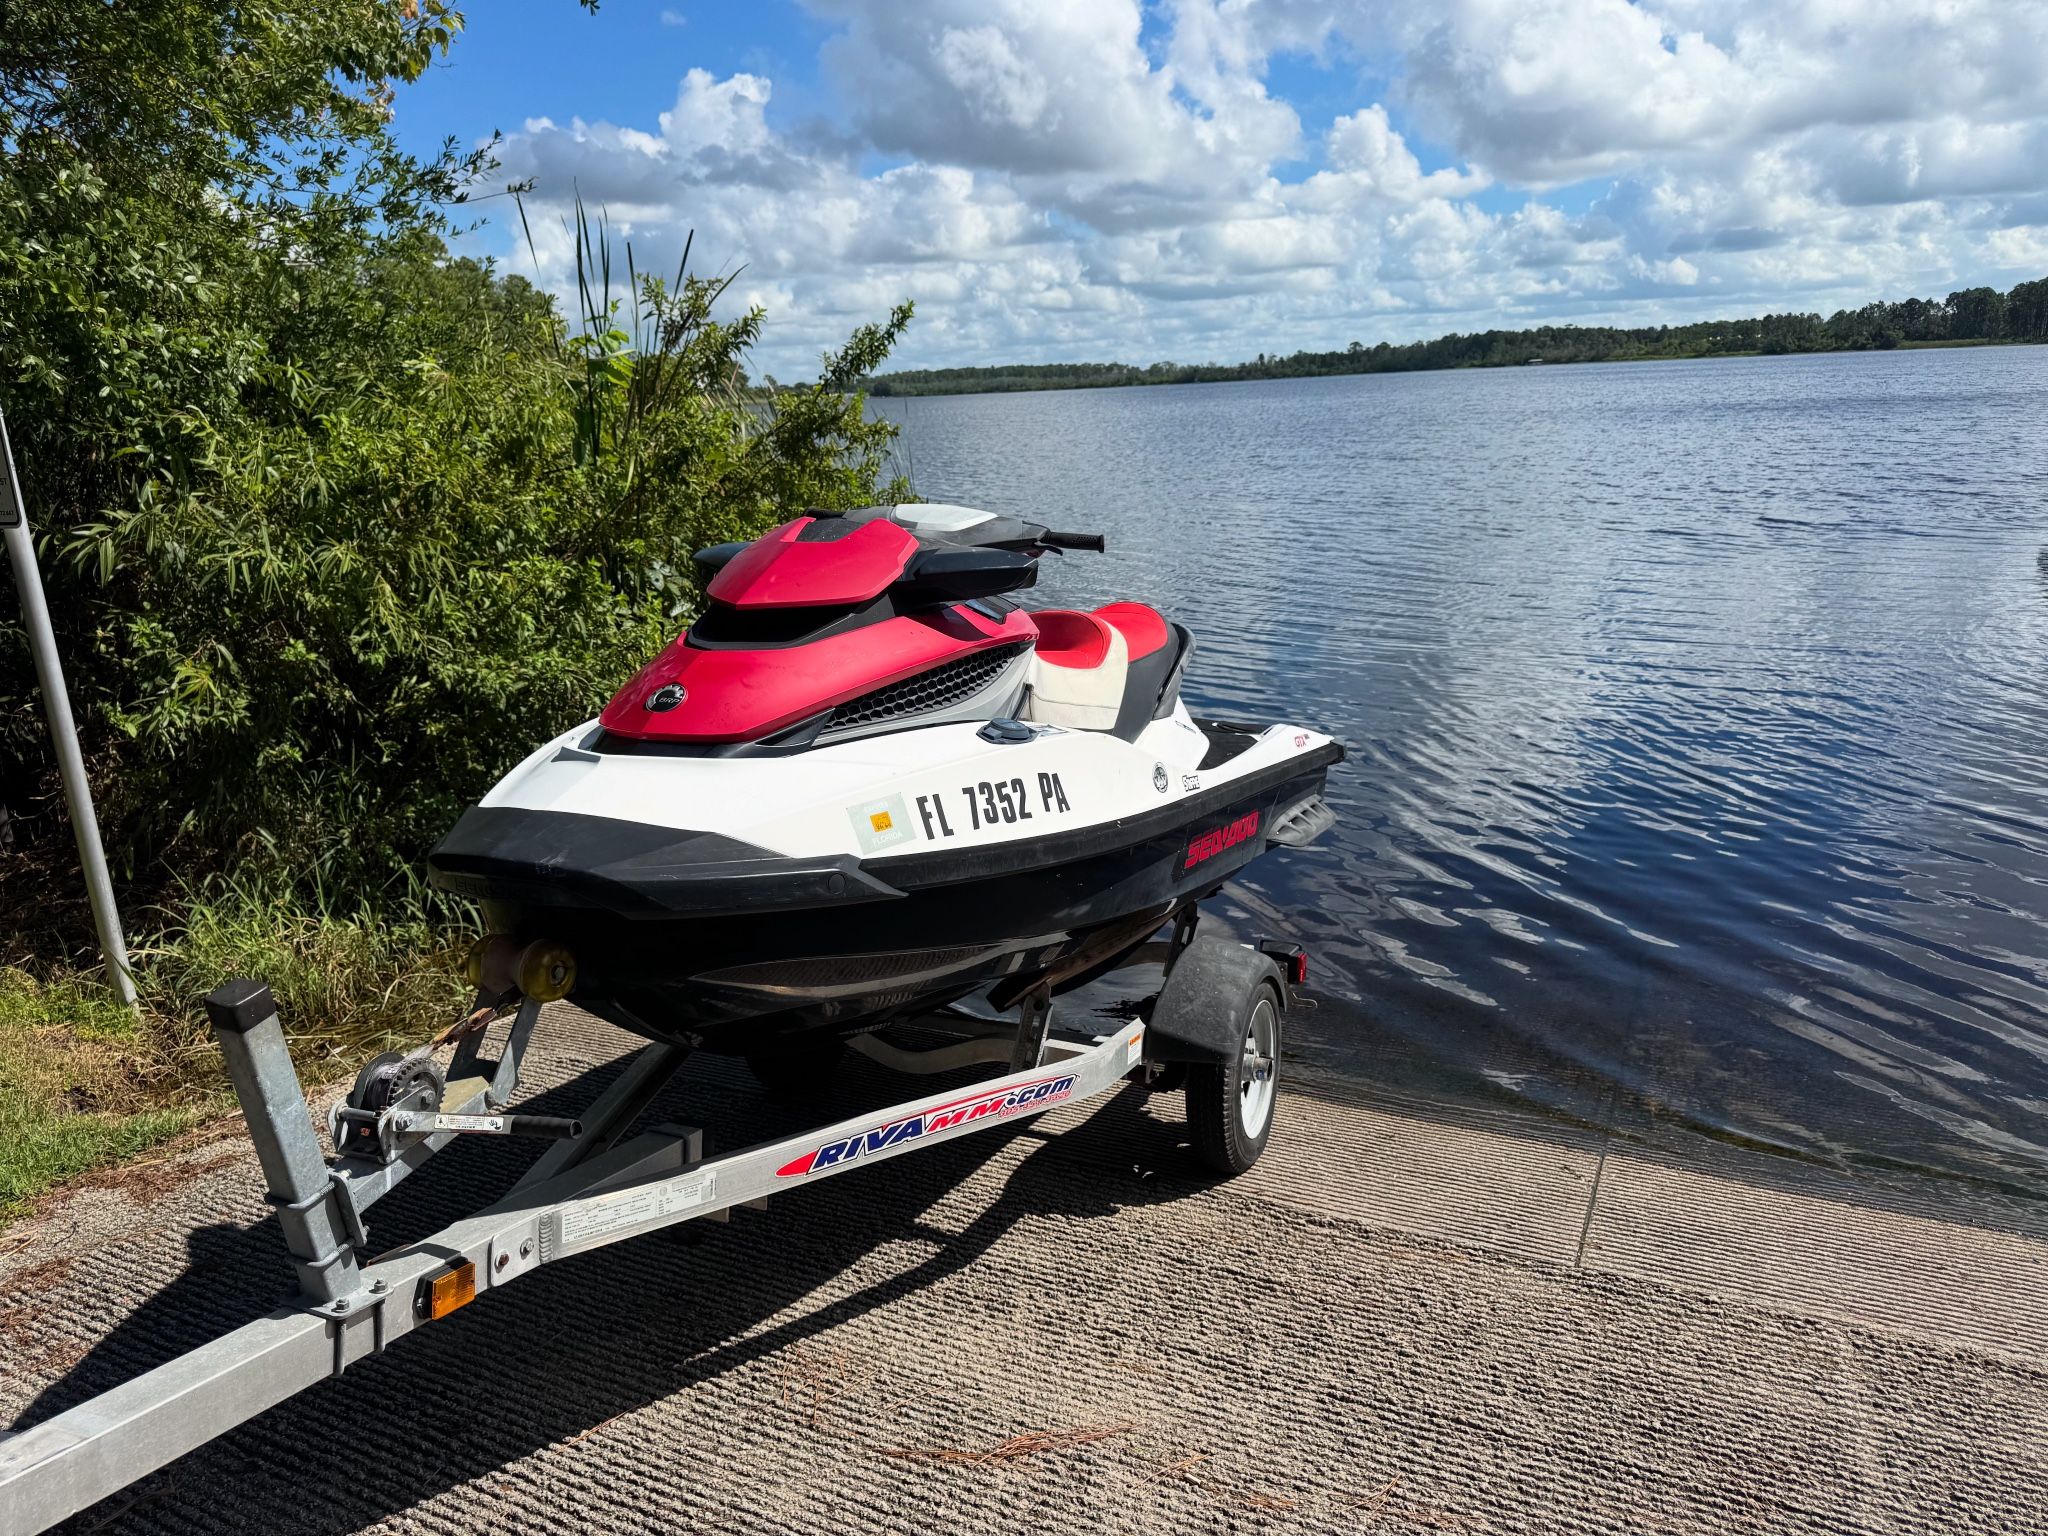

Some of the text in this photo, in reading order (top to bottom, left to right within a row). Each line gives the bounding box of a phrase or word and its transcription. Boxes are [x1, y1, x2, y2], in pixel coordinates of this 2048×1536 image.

[915, 793, 954, 841] FL
[962, 777, 1033, 831] 7352
[1037, 771, 1071, 814] PA
